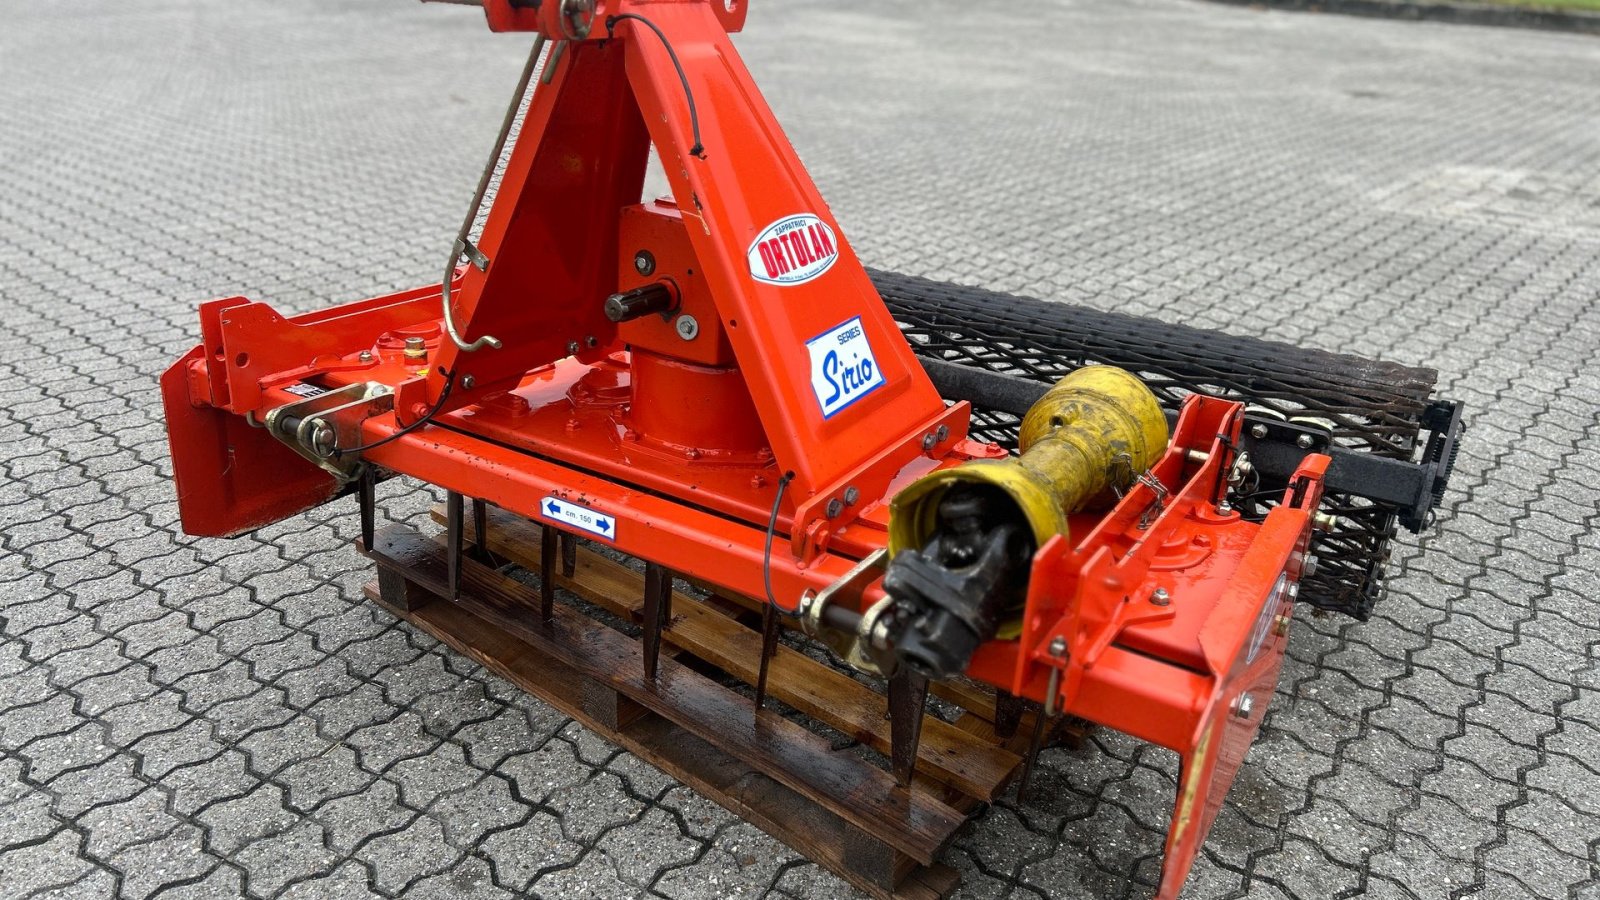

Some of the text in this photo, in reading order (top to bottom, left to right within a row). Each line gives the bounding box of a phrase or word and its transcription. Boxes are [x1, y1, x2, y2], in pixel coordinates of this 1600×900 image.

[774, 219, 807, 236] ZAPPATRICI
[757, 222, 835, 279] ORTOLAN
[837, 325, 861, 345] SERIES
[822, 349, 872, 407] Sirio
[579, 514, 592, 524] 150
